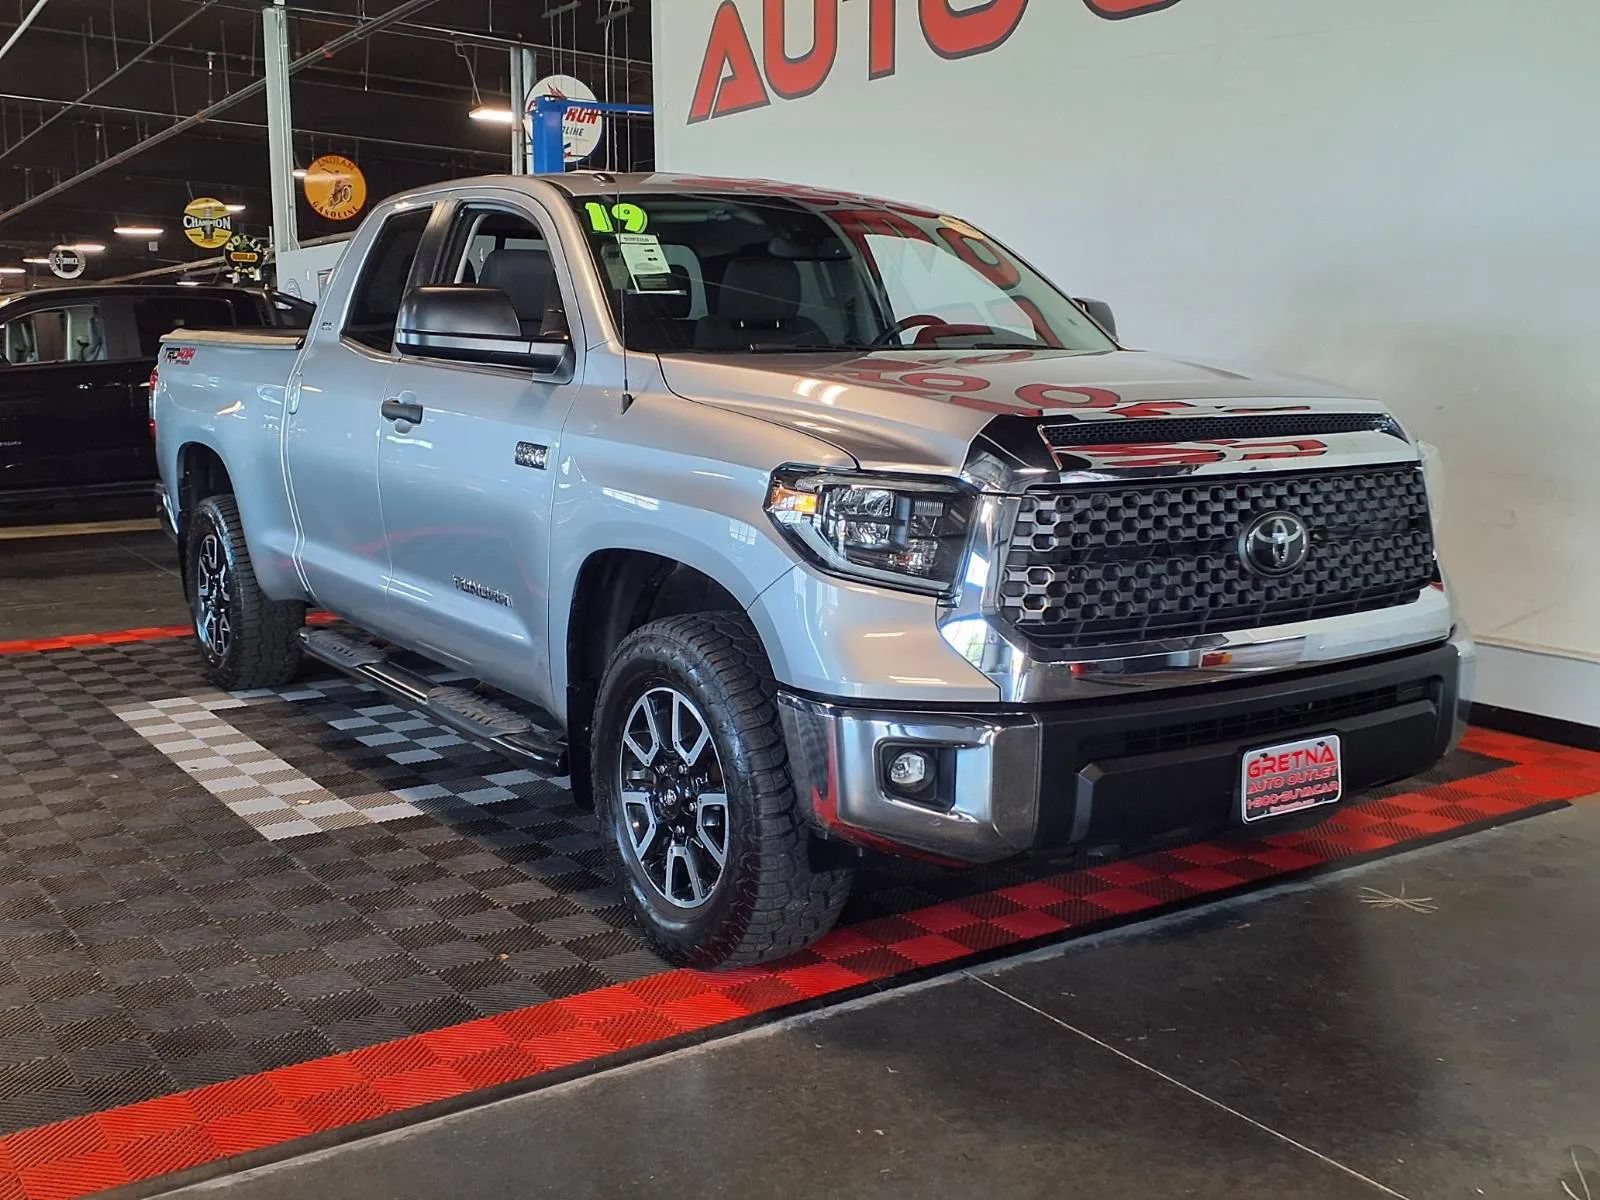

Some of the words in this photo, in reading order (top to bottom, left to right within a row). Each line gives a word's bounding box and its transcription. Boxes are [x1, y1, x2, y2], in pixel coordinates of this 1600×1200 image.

[183, 215, 231, 230] CHAMPION
[312, 201, 358, 218] GASOLINE
[585, 202, 648, 233] 19
[1248, 744, 1336, 778] GRETNA
[1247, 777, 1284, 795] AUTO
[1287, 765, 1337, 786] OUTLET
